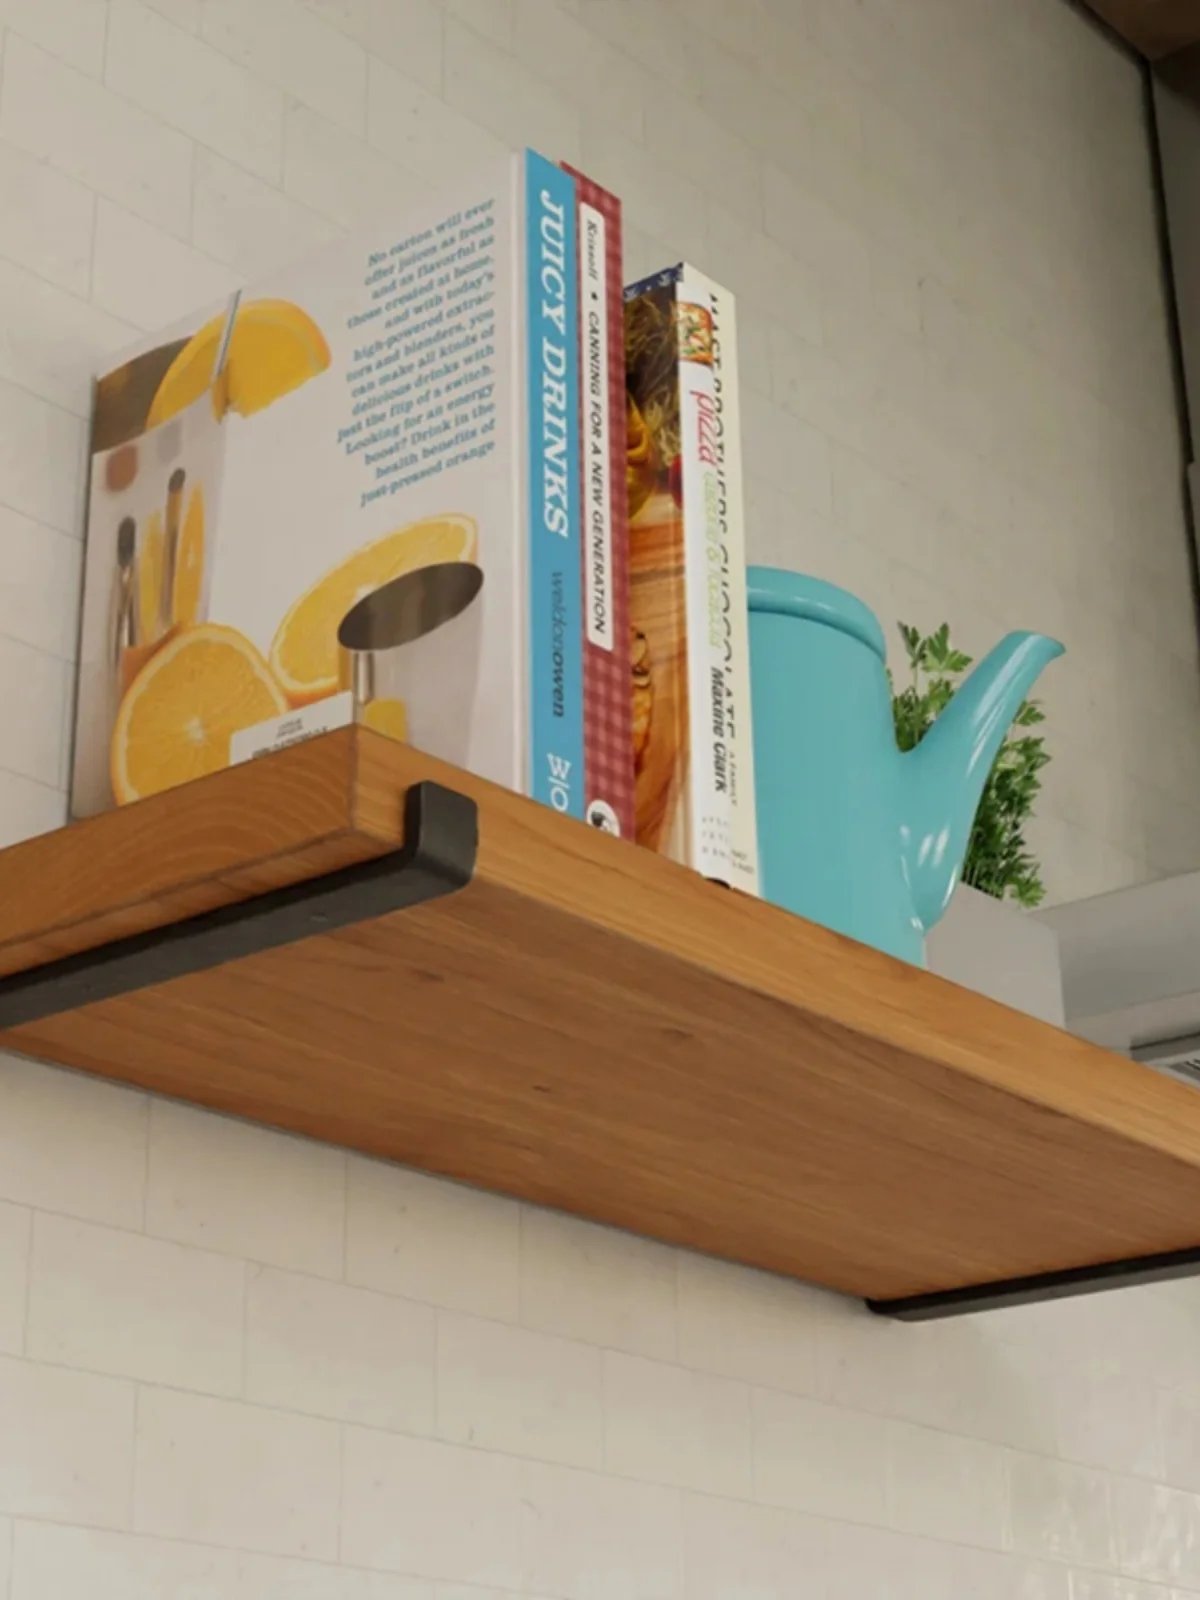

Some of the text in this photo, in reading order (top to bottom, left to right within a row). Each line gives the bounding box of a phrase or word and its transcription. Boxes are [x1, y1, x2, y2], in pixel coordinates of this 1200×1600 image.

[540, 189, 569, 539] JUICY DRINKS
[689, 390, 717, 469] pizza
[588, 311, 606, 634] CANNING FOR A NEW GENERATION
[711, 666, 725, 738] Maxine
[713, 741, 727, 793] Clark
